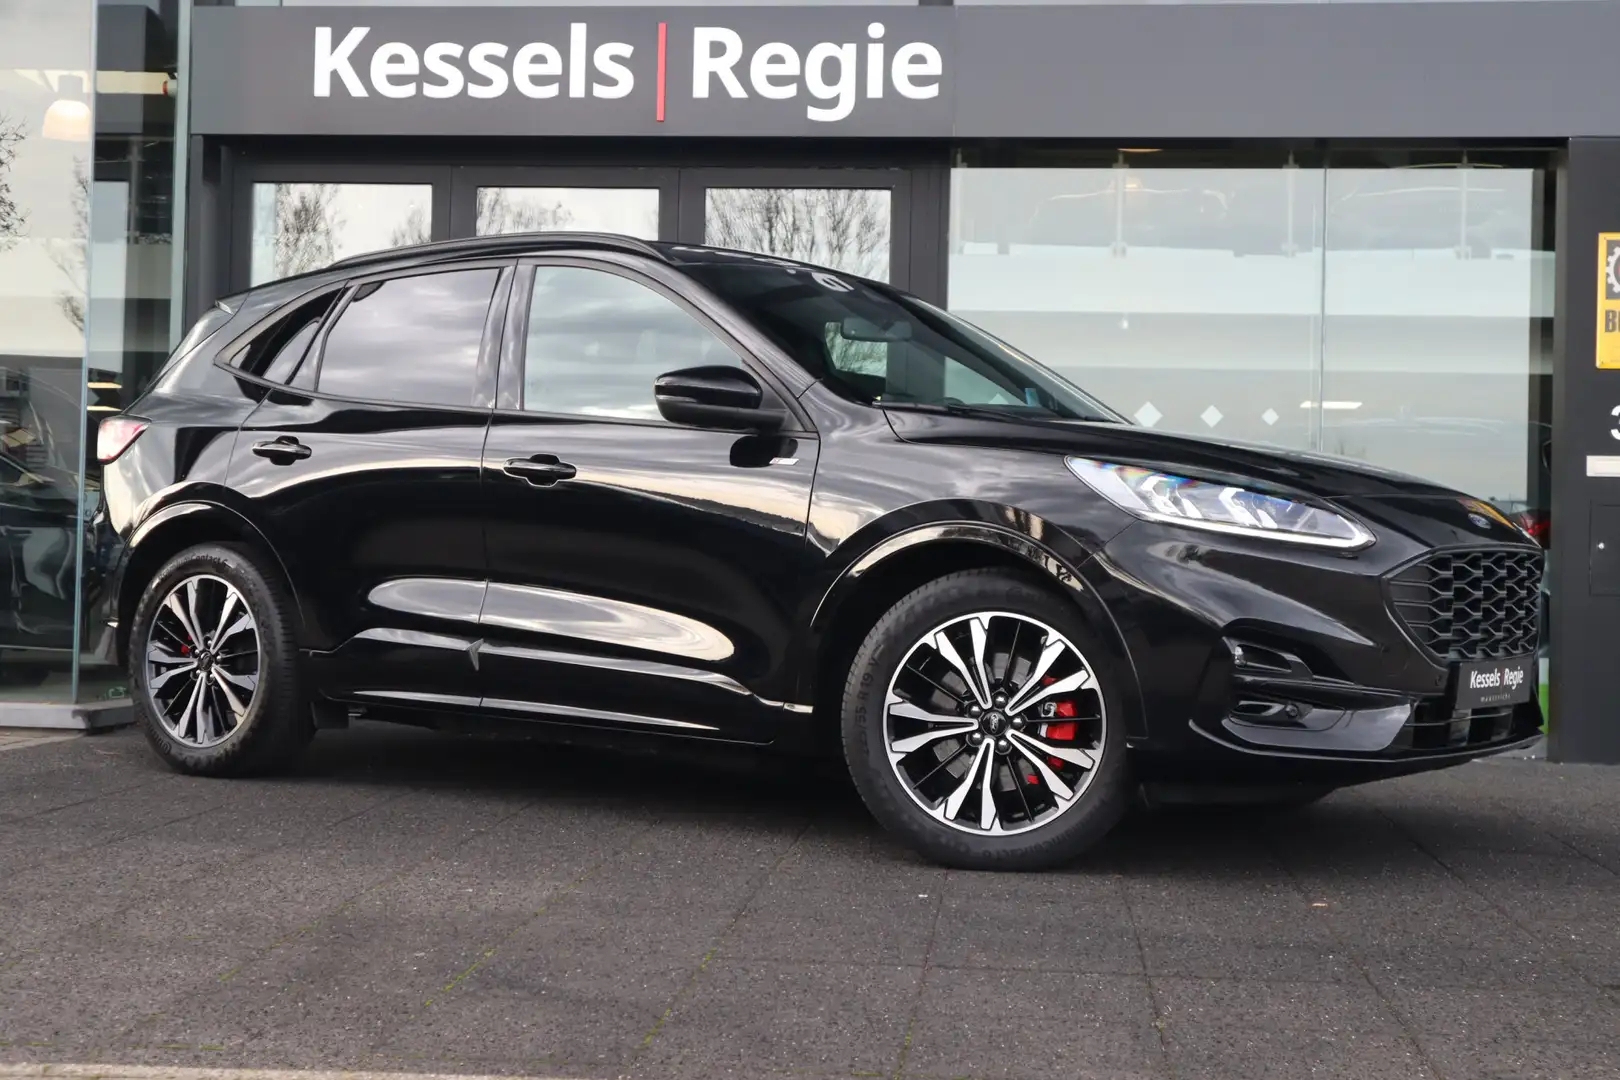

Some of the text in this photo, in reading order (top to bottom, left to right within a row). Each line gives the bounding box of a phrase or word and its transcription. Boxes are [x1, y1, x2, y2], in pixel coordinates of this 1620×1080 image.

[313, 22, 943, 122] Kessels Regie
[1469, 665, 1524, 690] Kessels Regie
